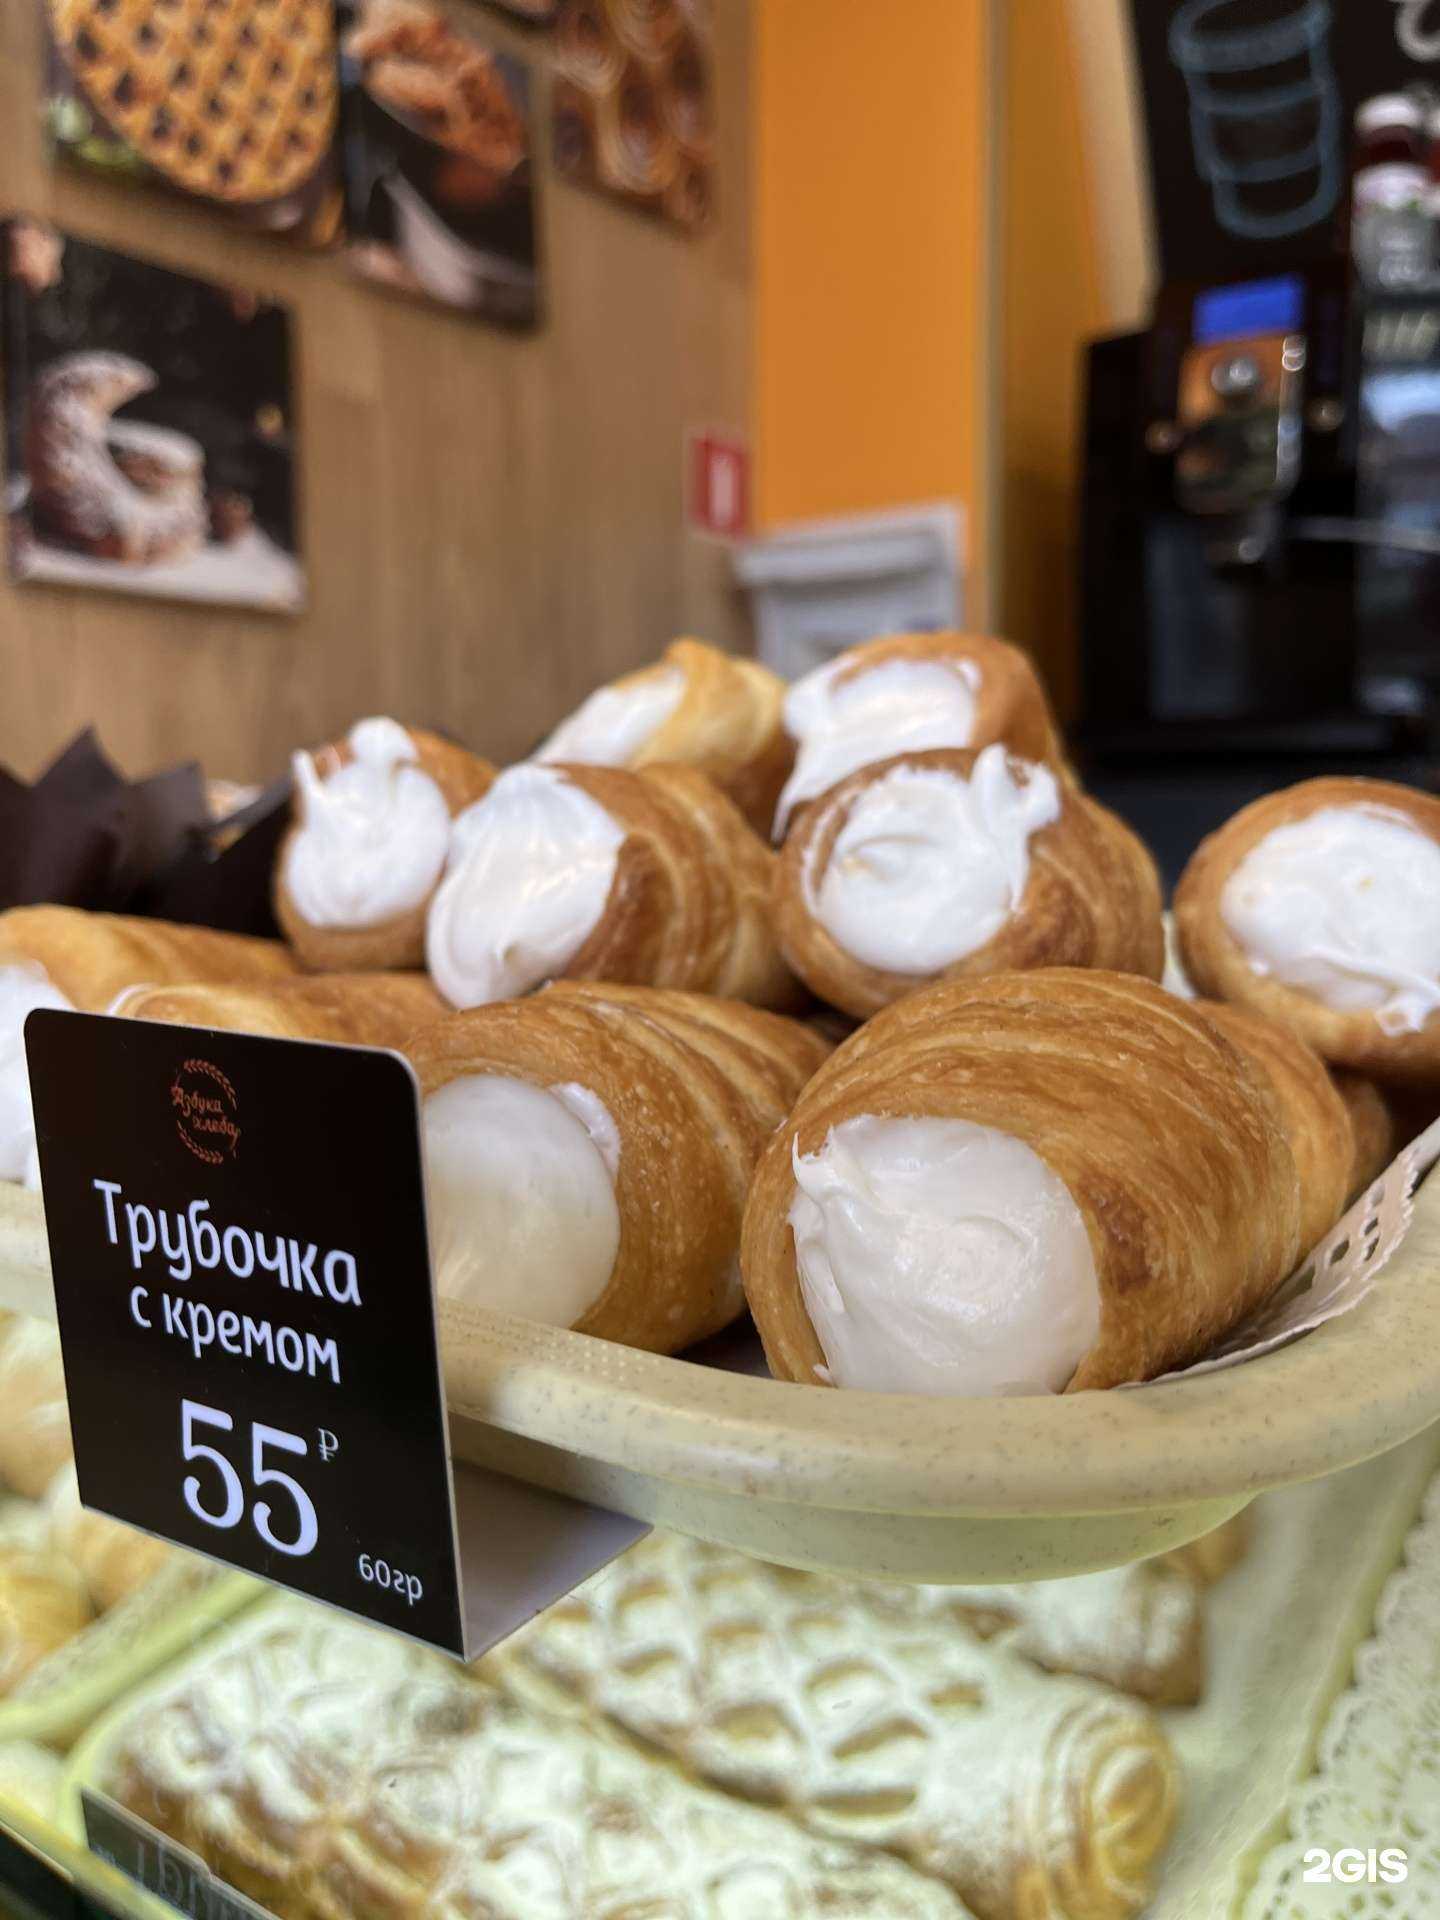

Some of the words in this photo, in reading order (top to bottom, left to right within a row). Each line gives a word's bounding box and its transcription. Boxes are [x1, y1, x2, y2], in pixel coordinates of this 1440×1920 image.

[93, 1178, 362, 1306] Трубочка
[130, 1285, 152, 1328] с
[163, 1293, 341, 1384] кремом
[181, 1398, 319, 1557] 55
[358, 1553, 424, 1606] 60гр
